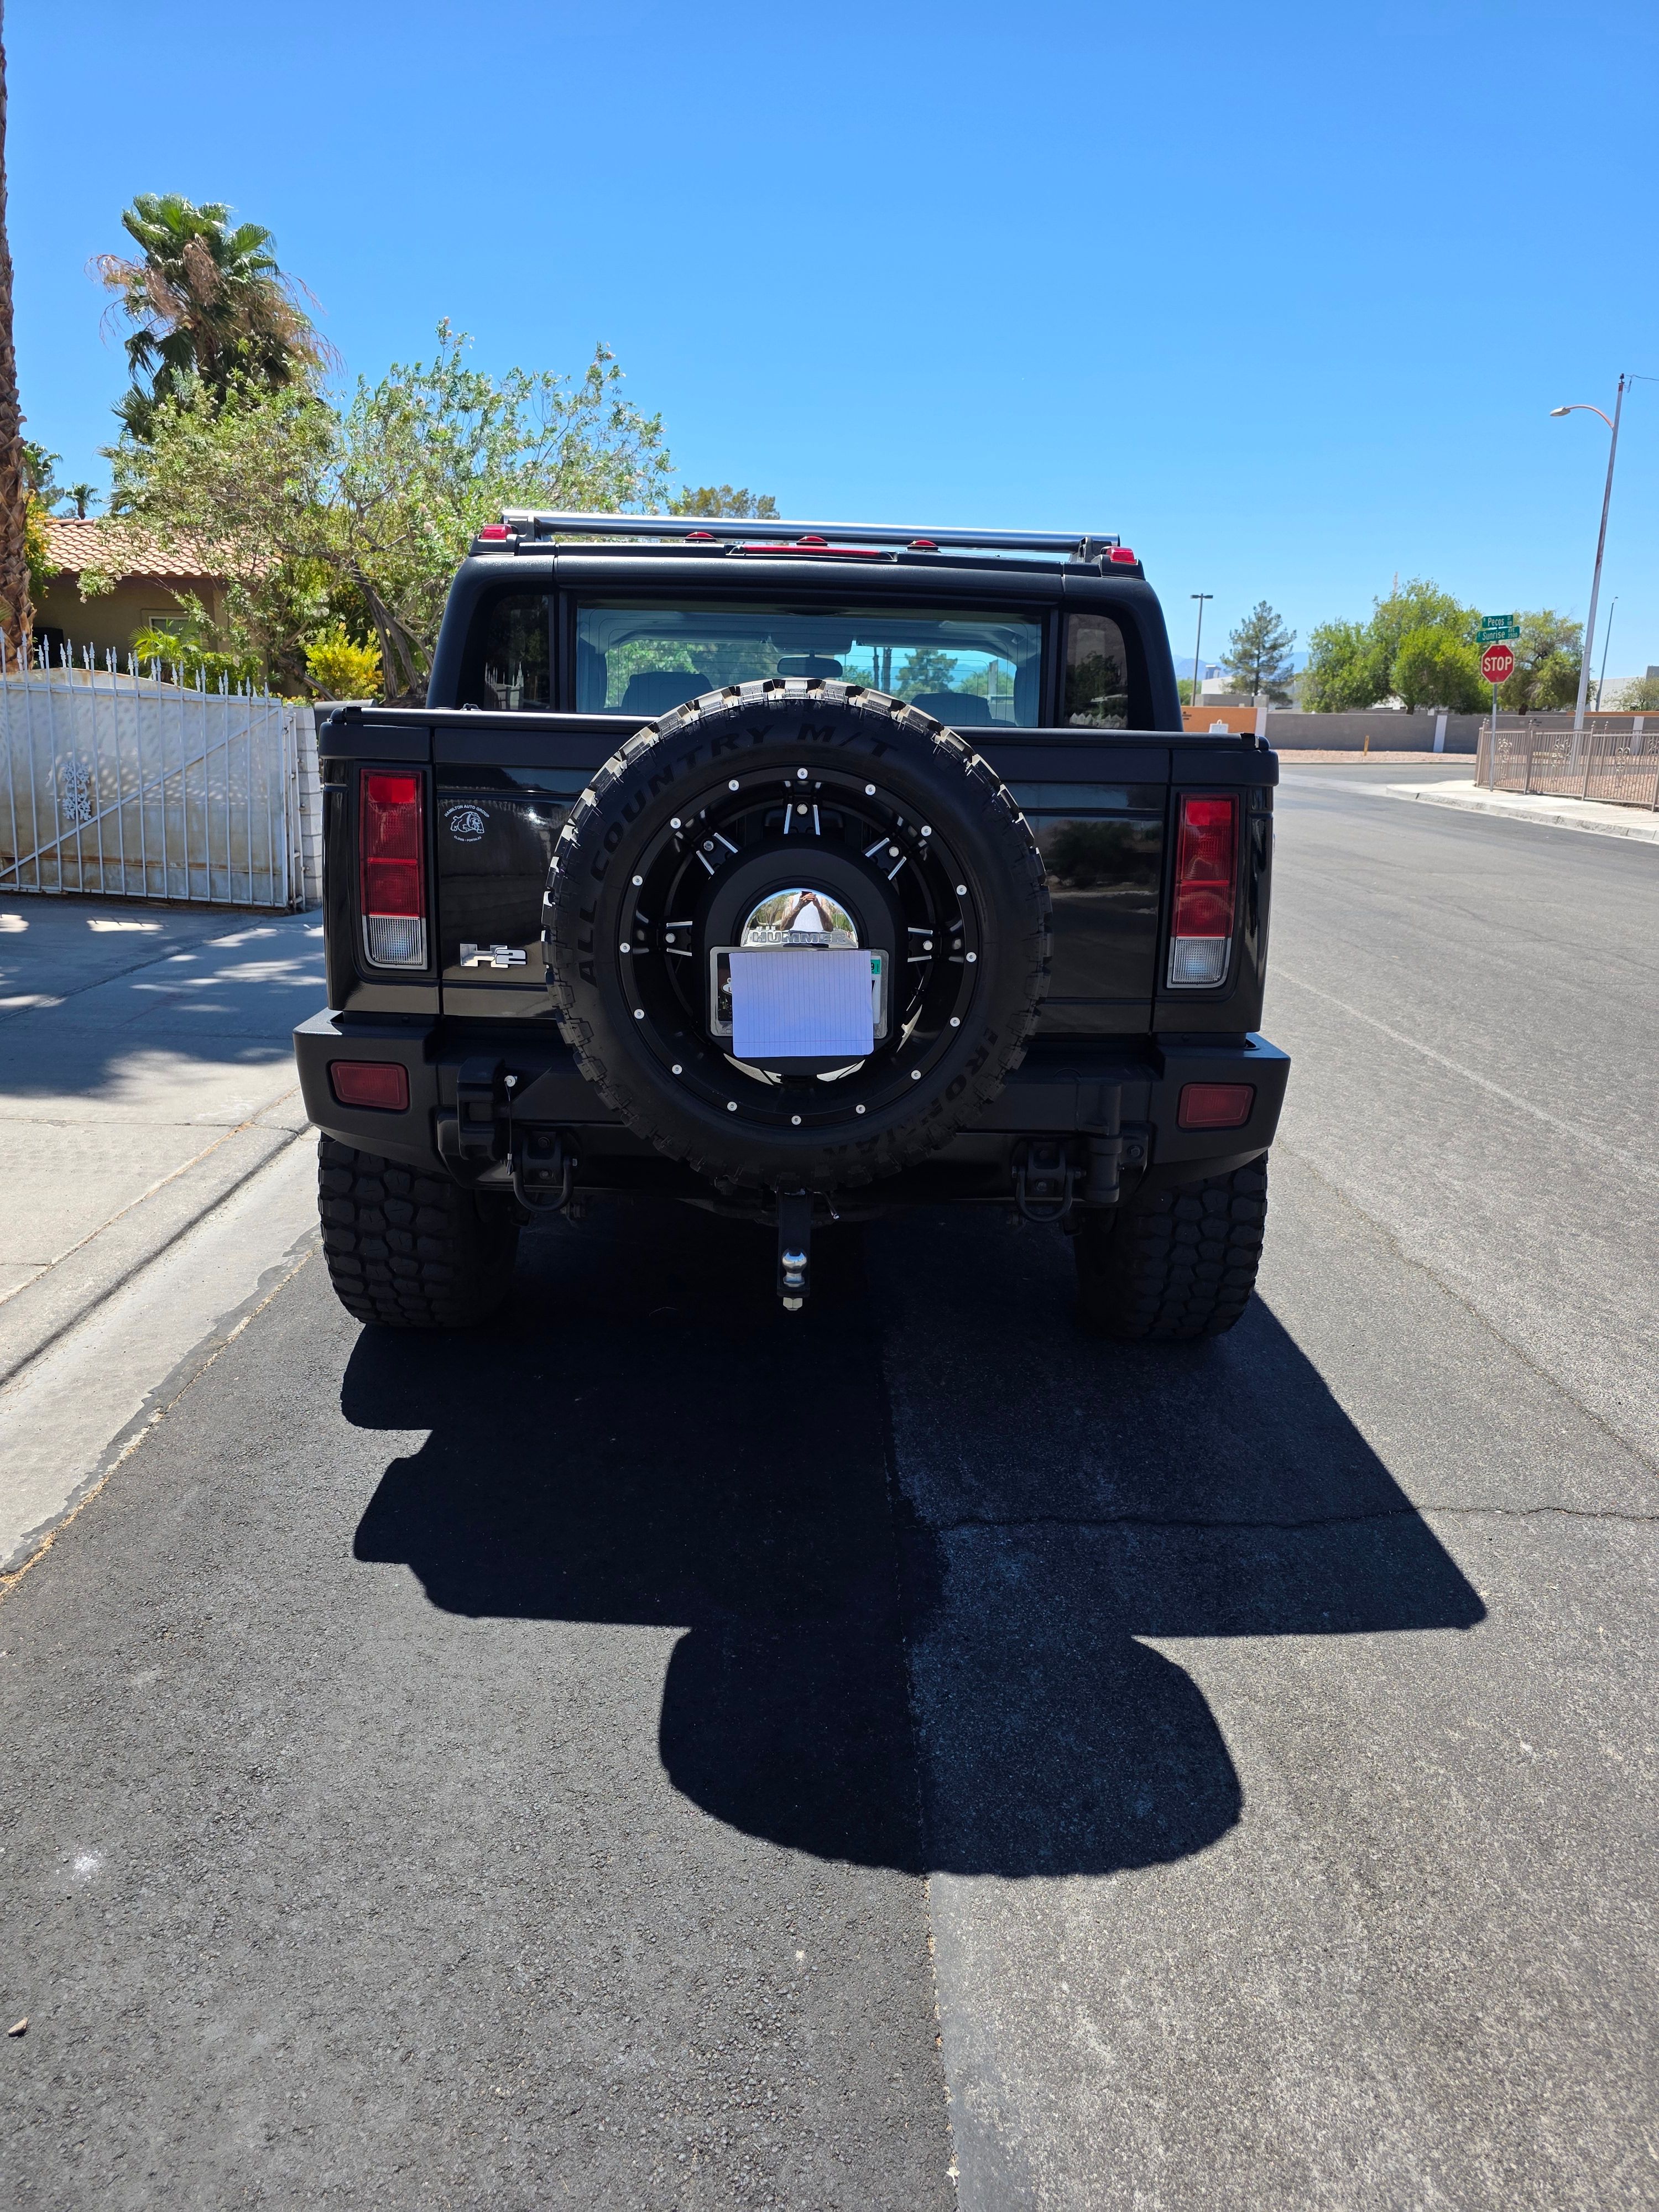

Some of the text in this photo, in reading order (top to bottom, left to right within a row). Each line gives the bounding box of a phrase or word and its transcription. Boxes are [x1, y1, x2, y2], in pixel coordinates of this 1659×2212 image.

[1488, 617, 1504, 627] Pecos
[1482, 630, 1505, 640] Sunrise
[1484, 656, 1512, 672] STOP
[444, 805, 463, 817] HAMILTON
[476, 807, 490, 818] GROUP
[579, 723, 900, 988] ALL COUNTRY M/T
[752, 931, 846, 944] HUMMER
[460, 943, 527, 968] H2
